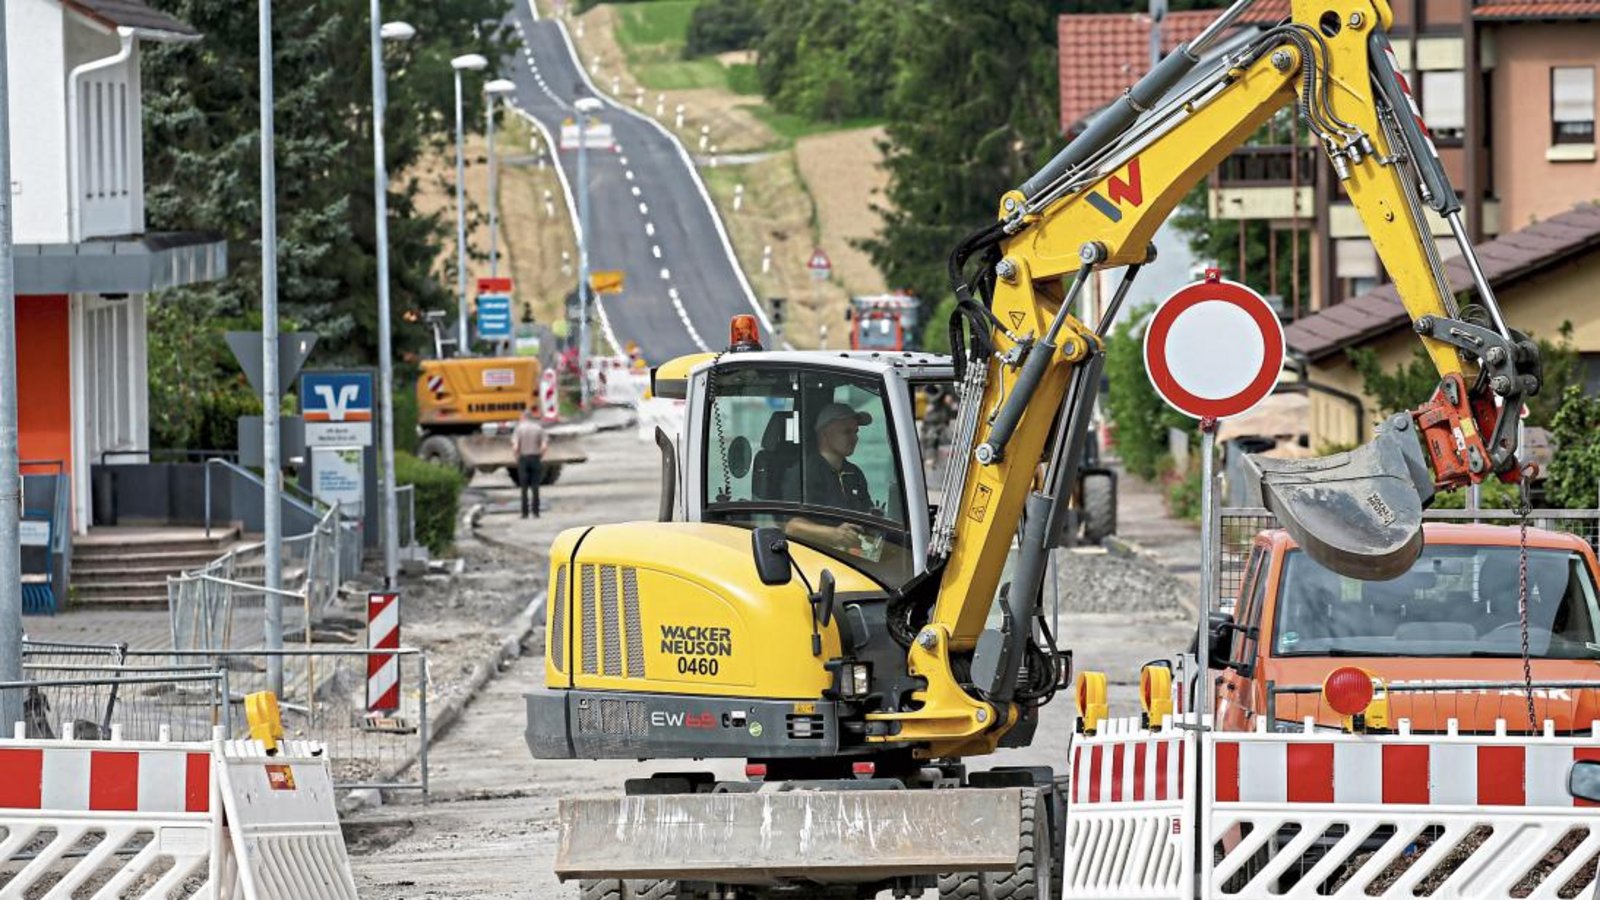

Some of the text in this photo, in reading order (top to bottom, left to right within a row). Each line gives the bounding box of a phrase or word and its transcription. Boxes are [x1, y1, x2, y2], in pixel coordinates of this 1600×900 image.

[660, 625, 731, 642] WACKER
[660, 640, 732, 656] NEUSON
[677, 656, 719, 676] 0460
